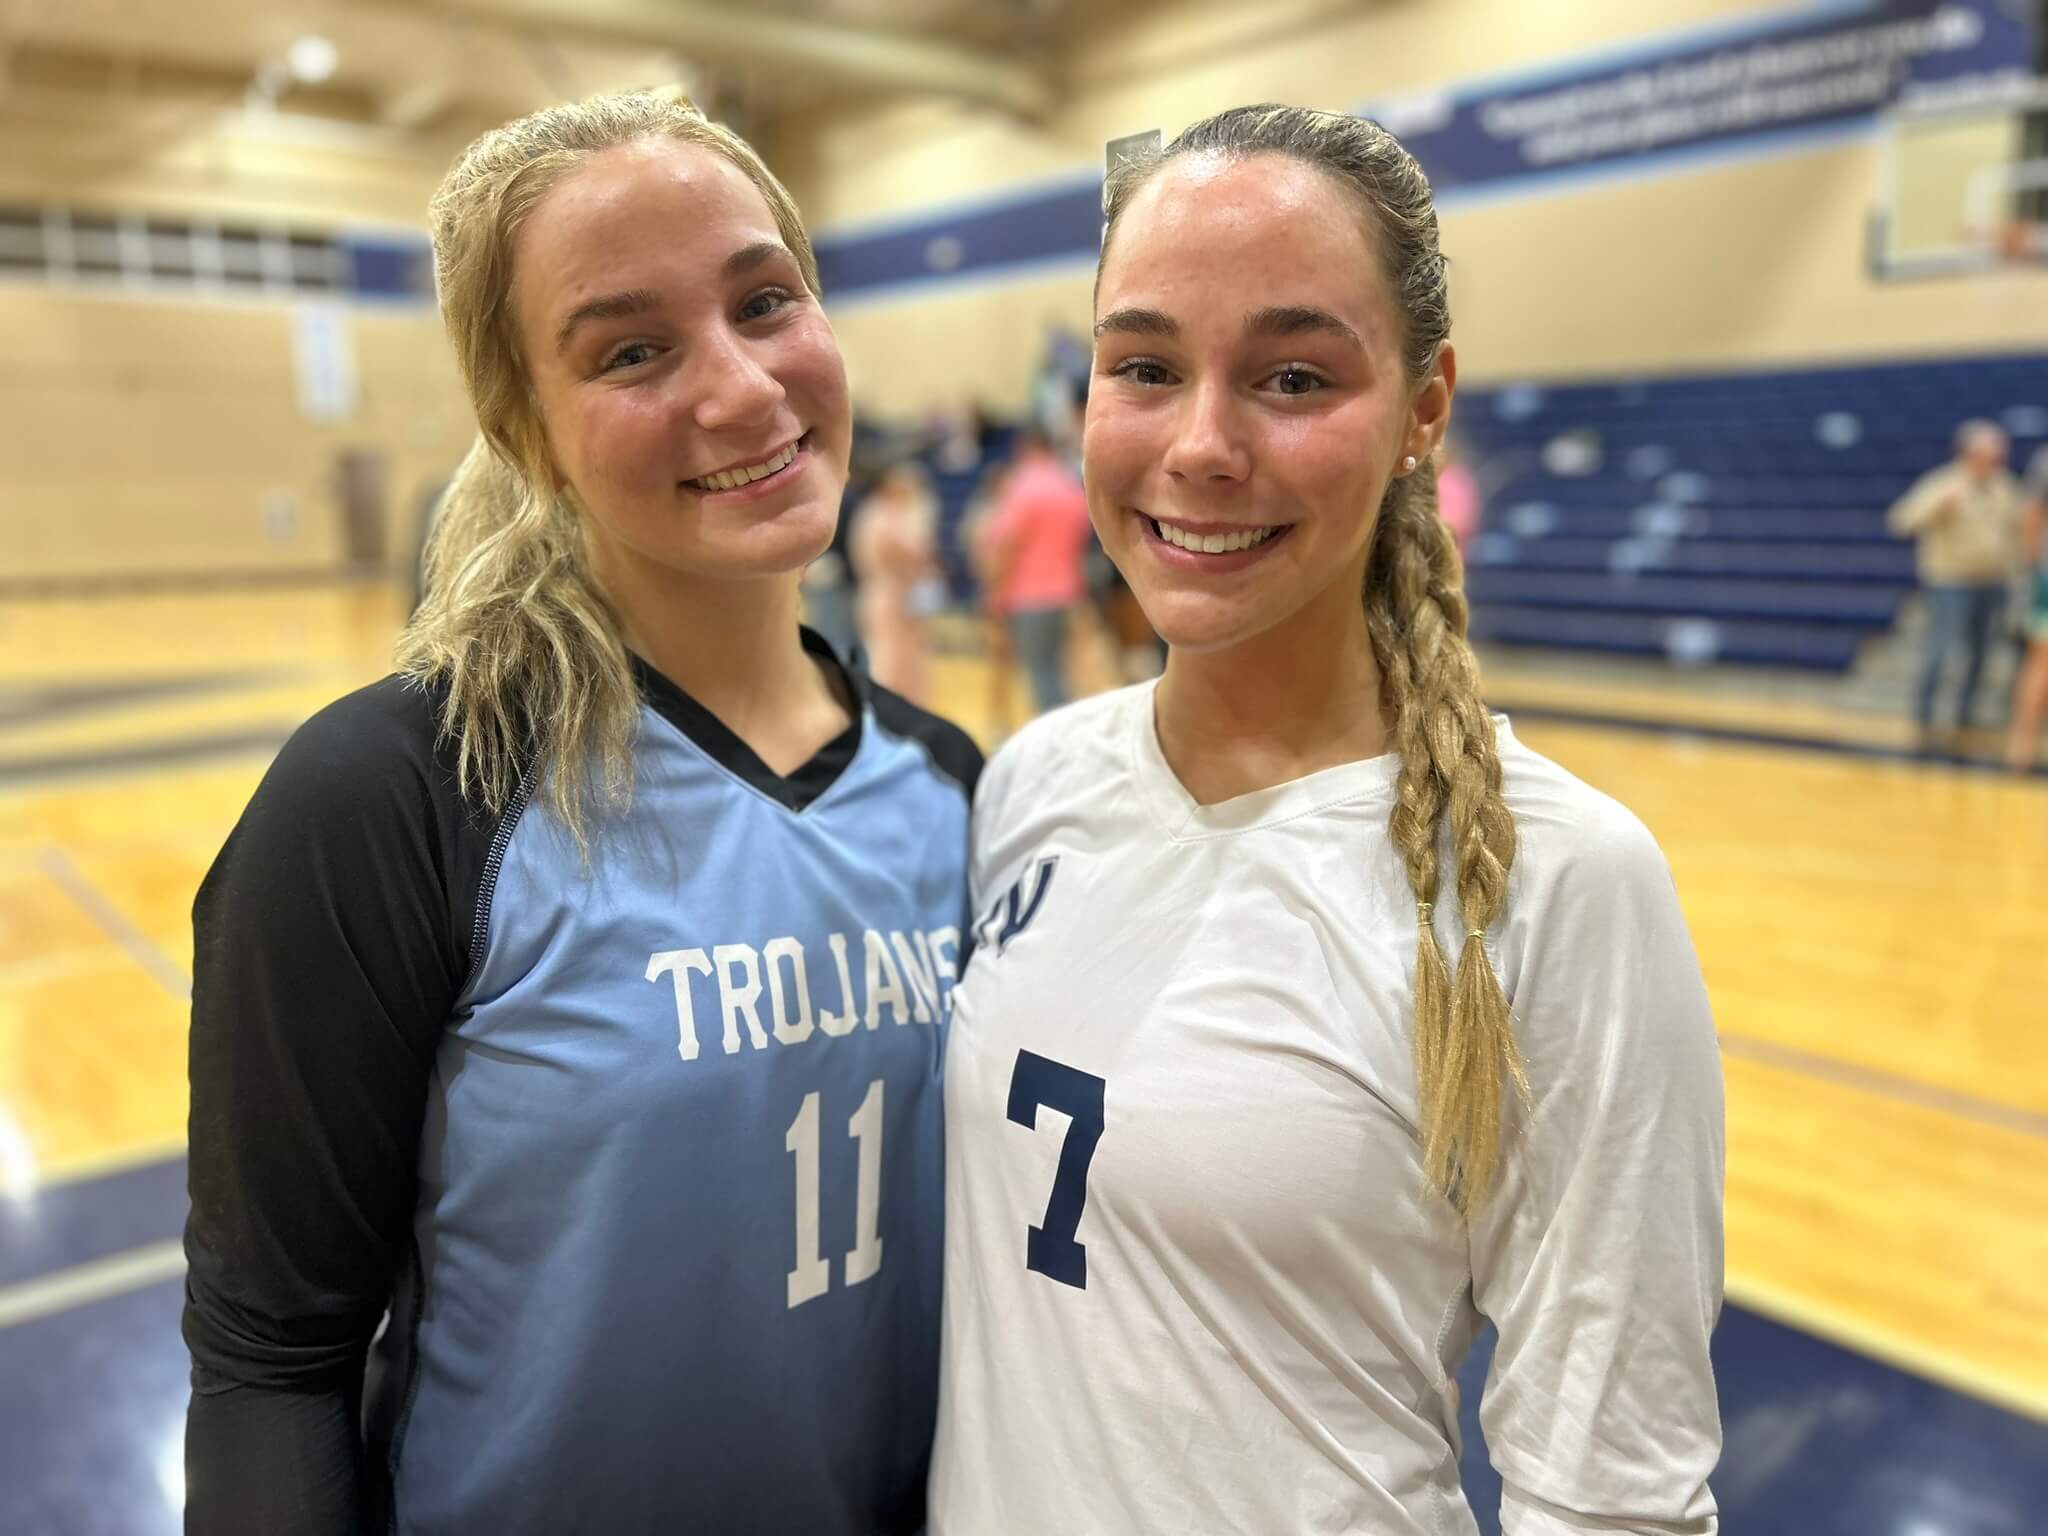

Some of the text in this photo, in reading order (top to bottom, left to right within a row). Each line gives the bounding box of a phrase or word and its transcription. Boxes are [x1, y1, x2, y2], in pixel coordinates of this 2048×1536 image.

[644, 924, 960, 1061] TROJANS
[785, 1079, 885, 1309] 11
[1006, 1048, 1107, 1290] 7
